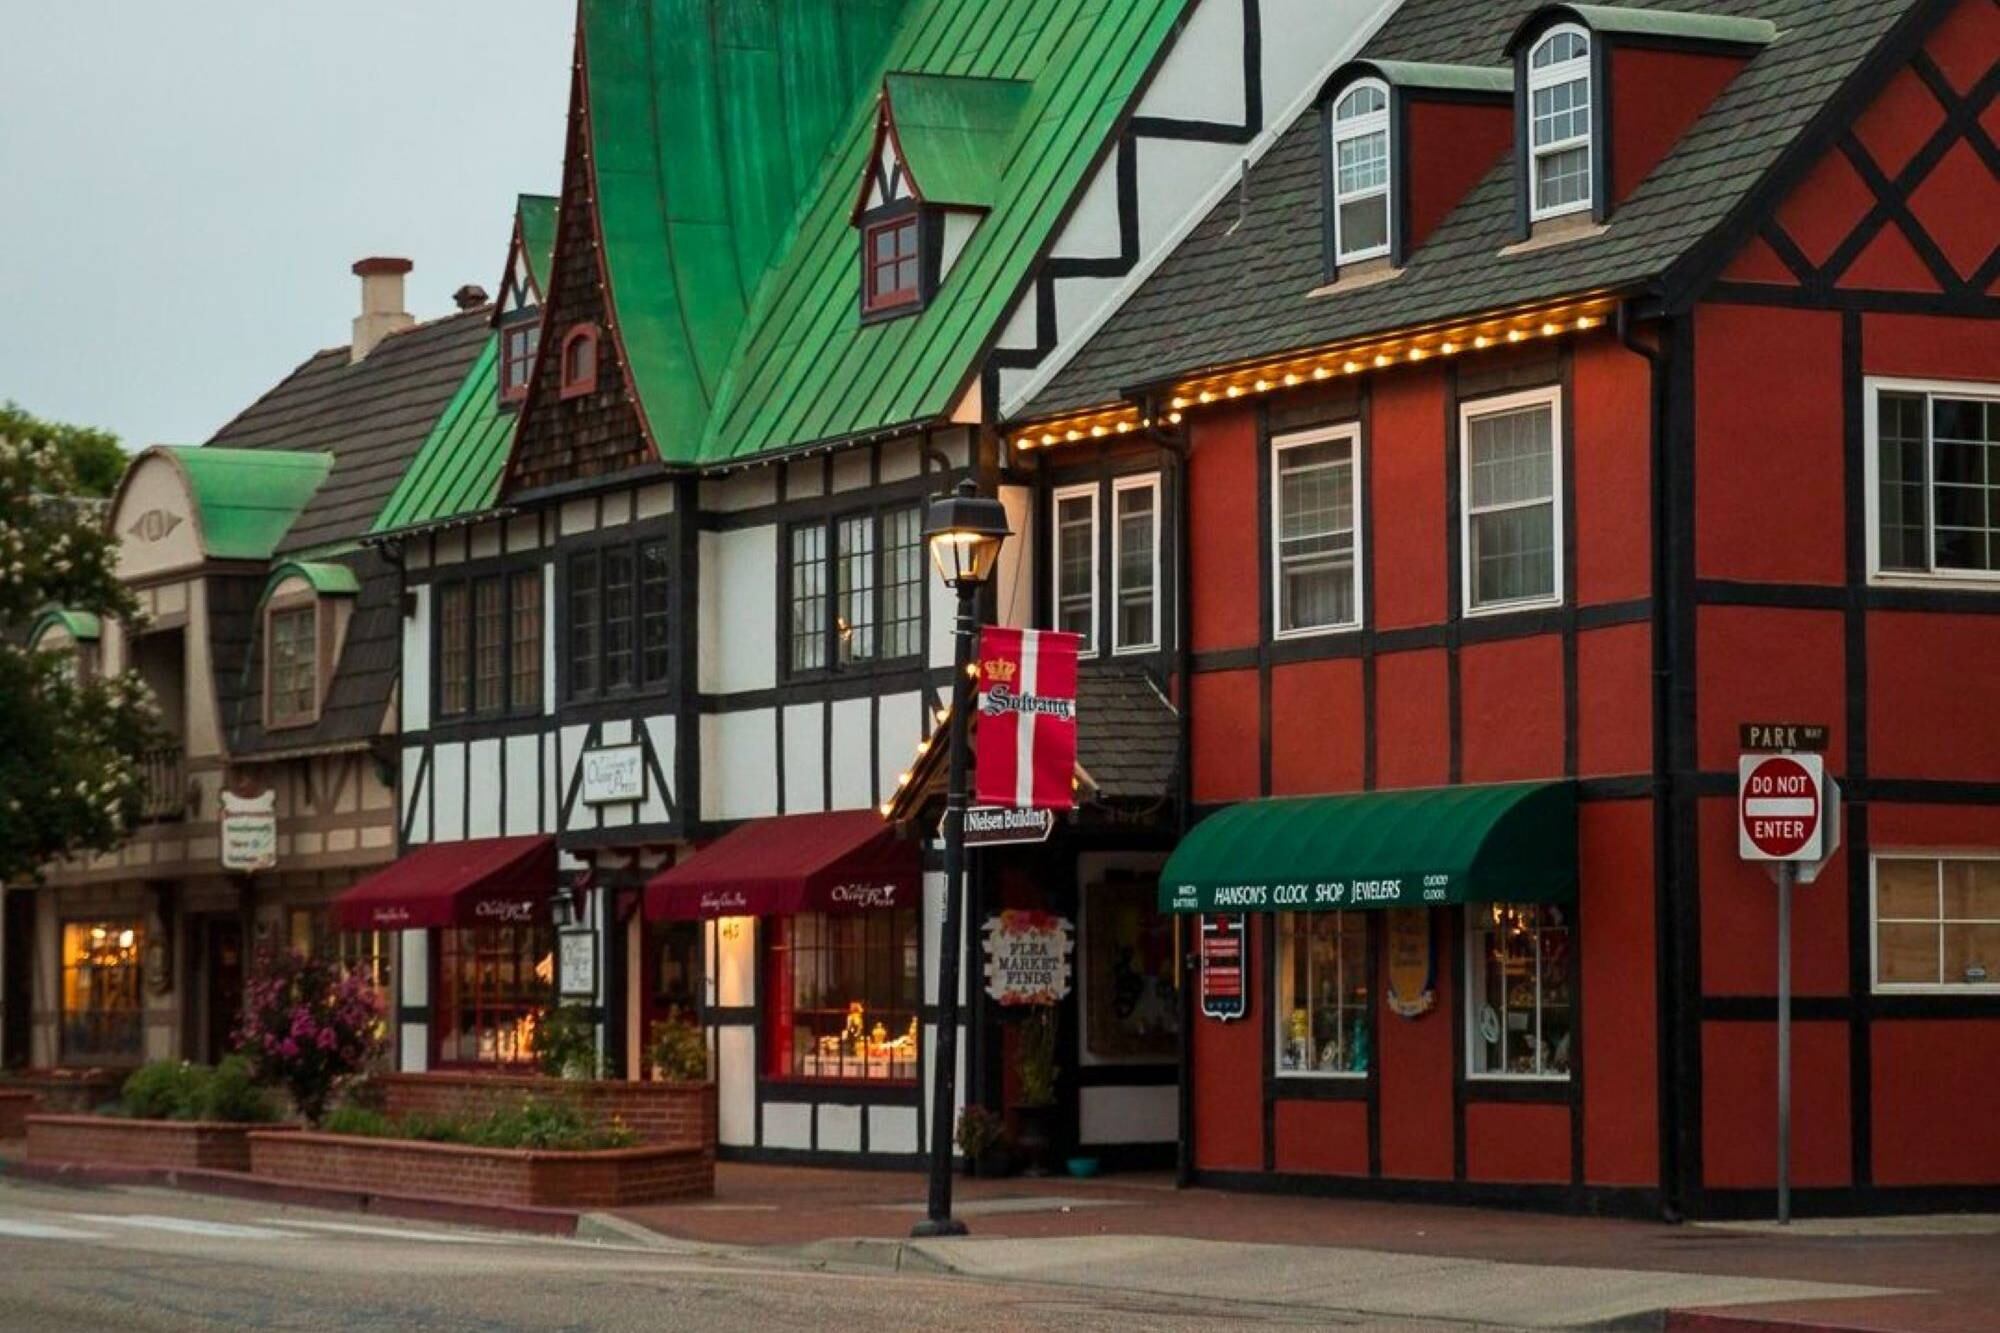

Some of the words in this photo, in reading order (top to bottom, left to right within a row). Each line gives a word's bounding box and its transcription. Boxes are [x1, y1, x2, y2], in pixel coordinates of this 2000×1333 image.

[985, 684, 1070, 722] Solvang
[1750, 727, 1797, 747] PARK
[1804, 729, 1822, 738] WAY
[1752, 776, 1772, 793] DO
[1777, 775, 1807, 793] NOT
[969, 811, 1004, 832] Nielsen
[1004, 808, 1047, 830] Building
[1754, 821, 1804, 838] ENTER
[1214, 886, 1267, 905] HANSON'S
[1273, 884, 1308, 903] CLOCK
[1315, 882, 1345, 902] SHOP
[1351, 880, 1401, 903] JEWELERS
[1009, 943, 1047, 955] FLEA
[999, 957, 1057, 970] MARKET
[1006, 971, 1053, 985] FINDS
